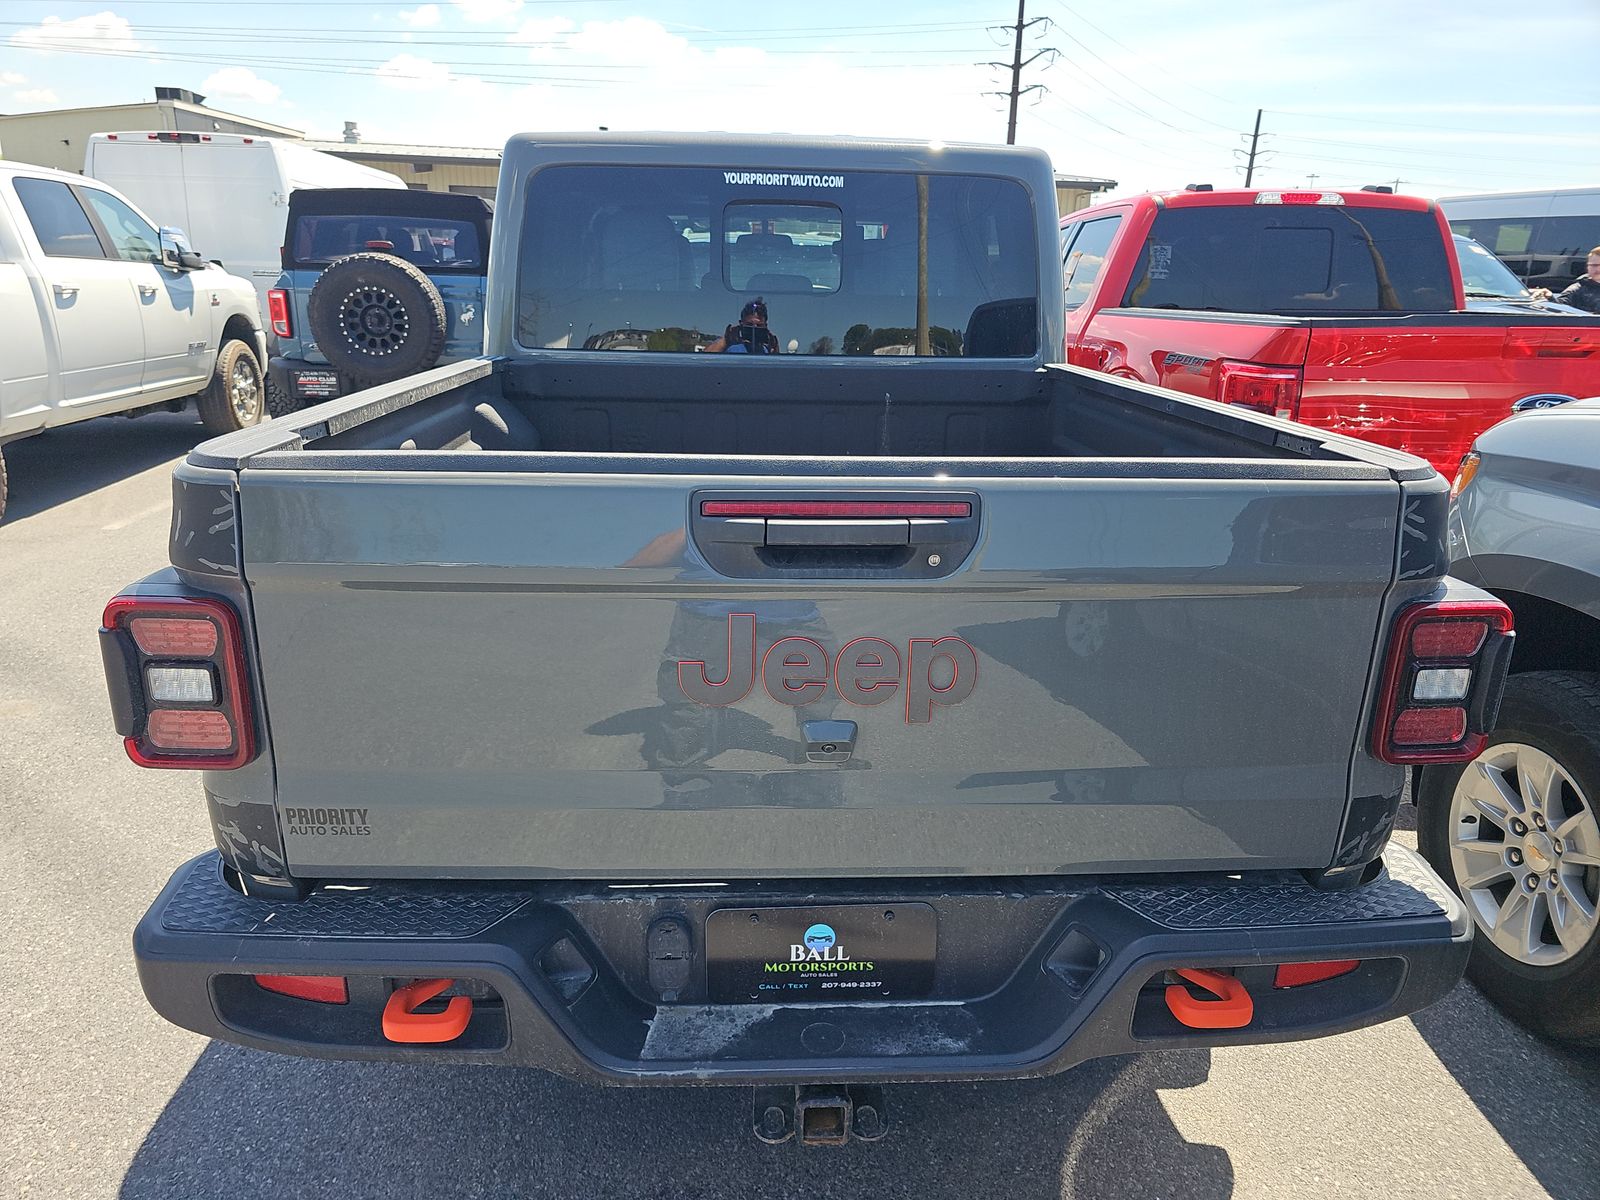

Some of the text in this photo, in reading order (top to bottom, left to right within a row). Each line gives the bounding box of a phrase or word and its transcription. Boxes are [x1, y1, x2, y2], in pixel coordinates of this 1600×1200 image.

[723, 172, 844, 188] YOURPRIORITYAUTO.COM
[1163, 353, 1209, 367] SPORT
[677, 612, 979, 725] Jeep
[285, 807, 368, 825] PRIORITY
[289, 825, 371, 836] AUTO SALES
[790, 944, 850, 962] BALL
[764, 961, 875, 973] MOTORSPORTS
